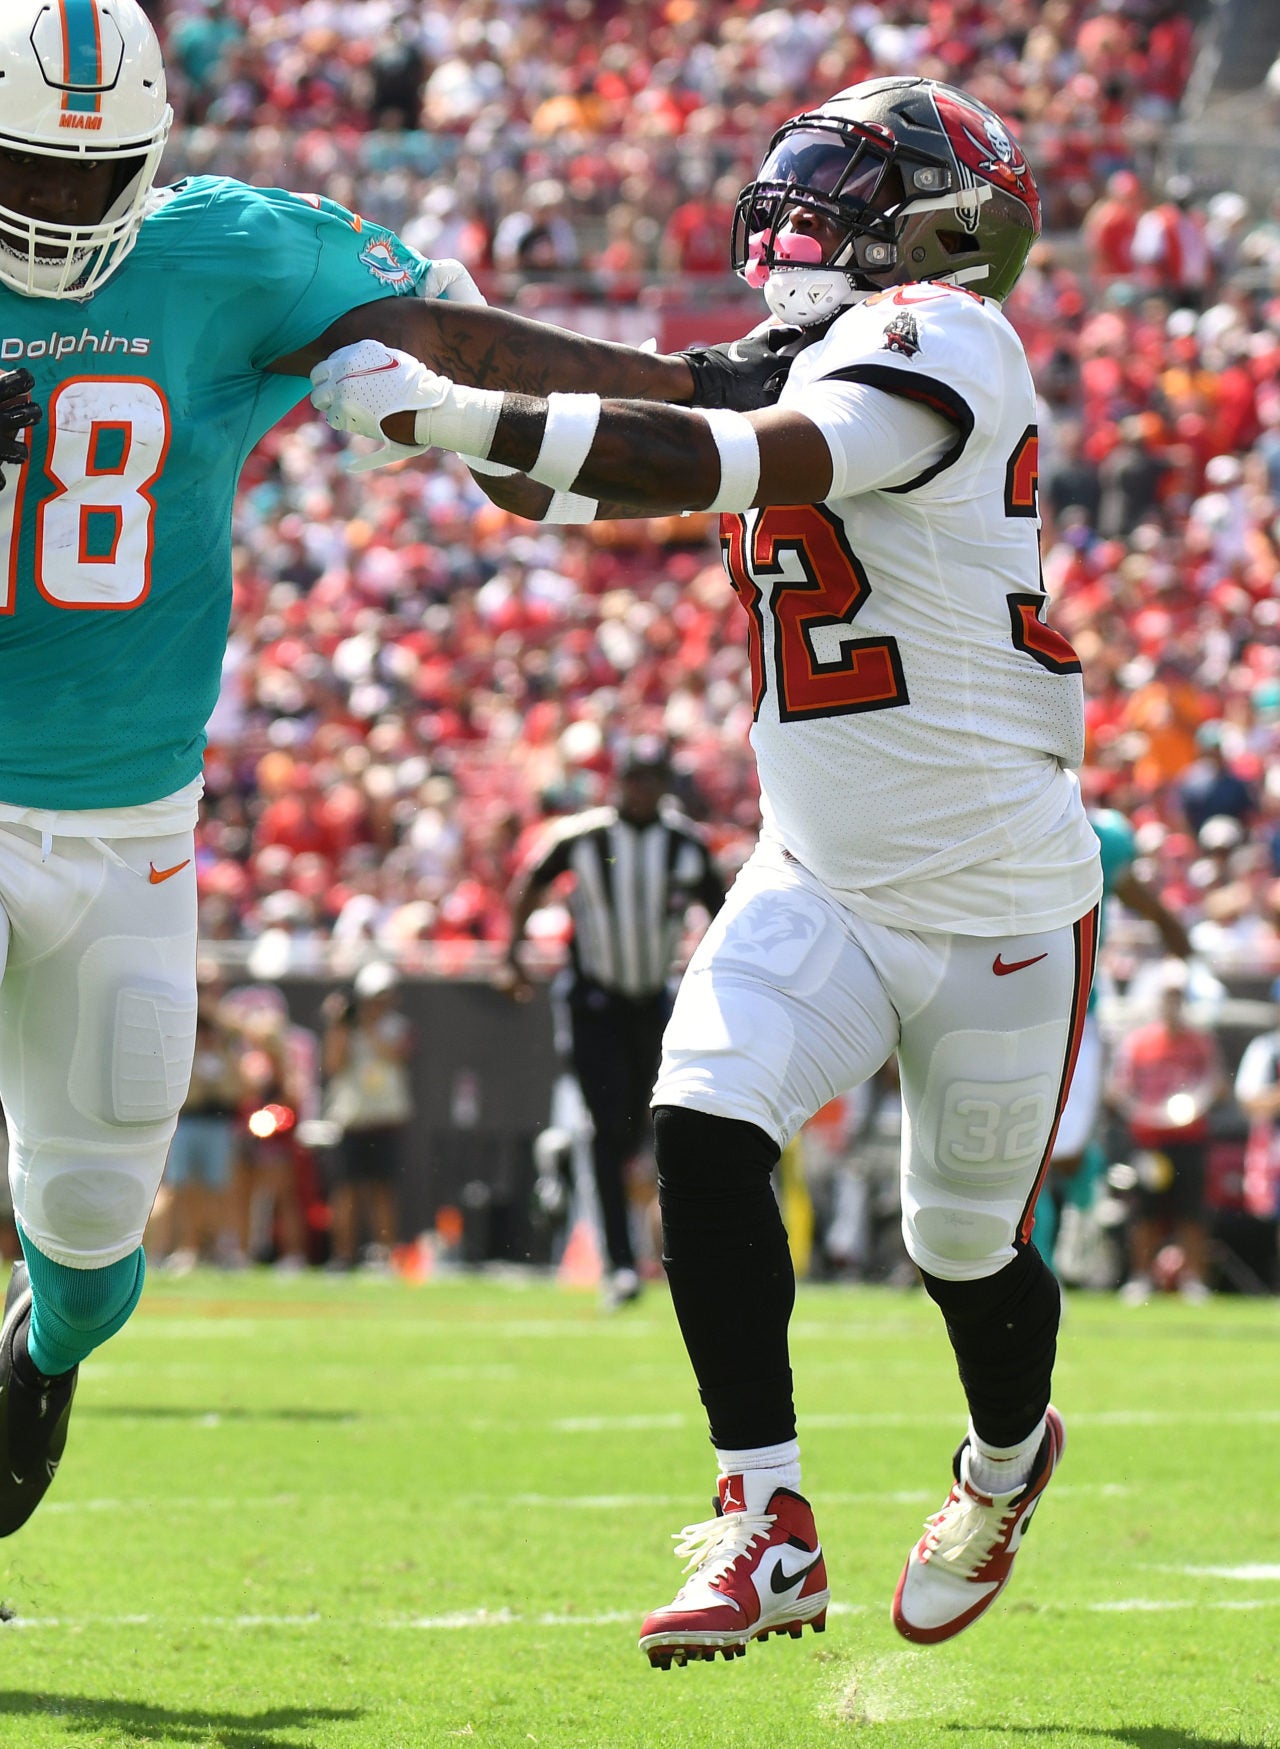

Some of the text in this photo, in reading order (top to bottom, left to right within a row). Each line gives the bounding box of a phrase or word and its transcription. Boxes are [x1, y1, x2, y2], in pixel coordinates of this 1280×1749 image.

[58, 113, 103, 130] MIAMI
[1, 327, 151, 361] Dolphins
[950, 1092, 1046, 1163] 32
